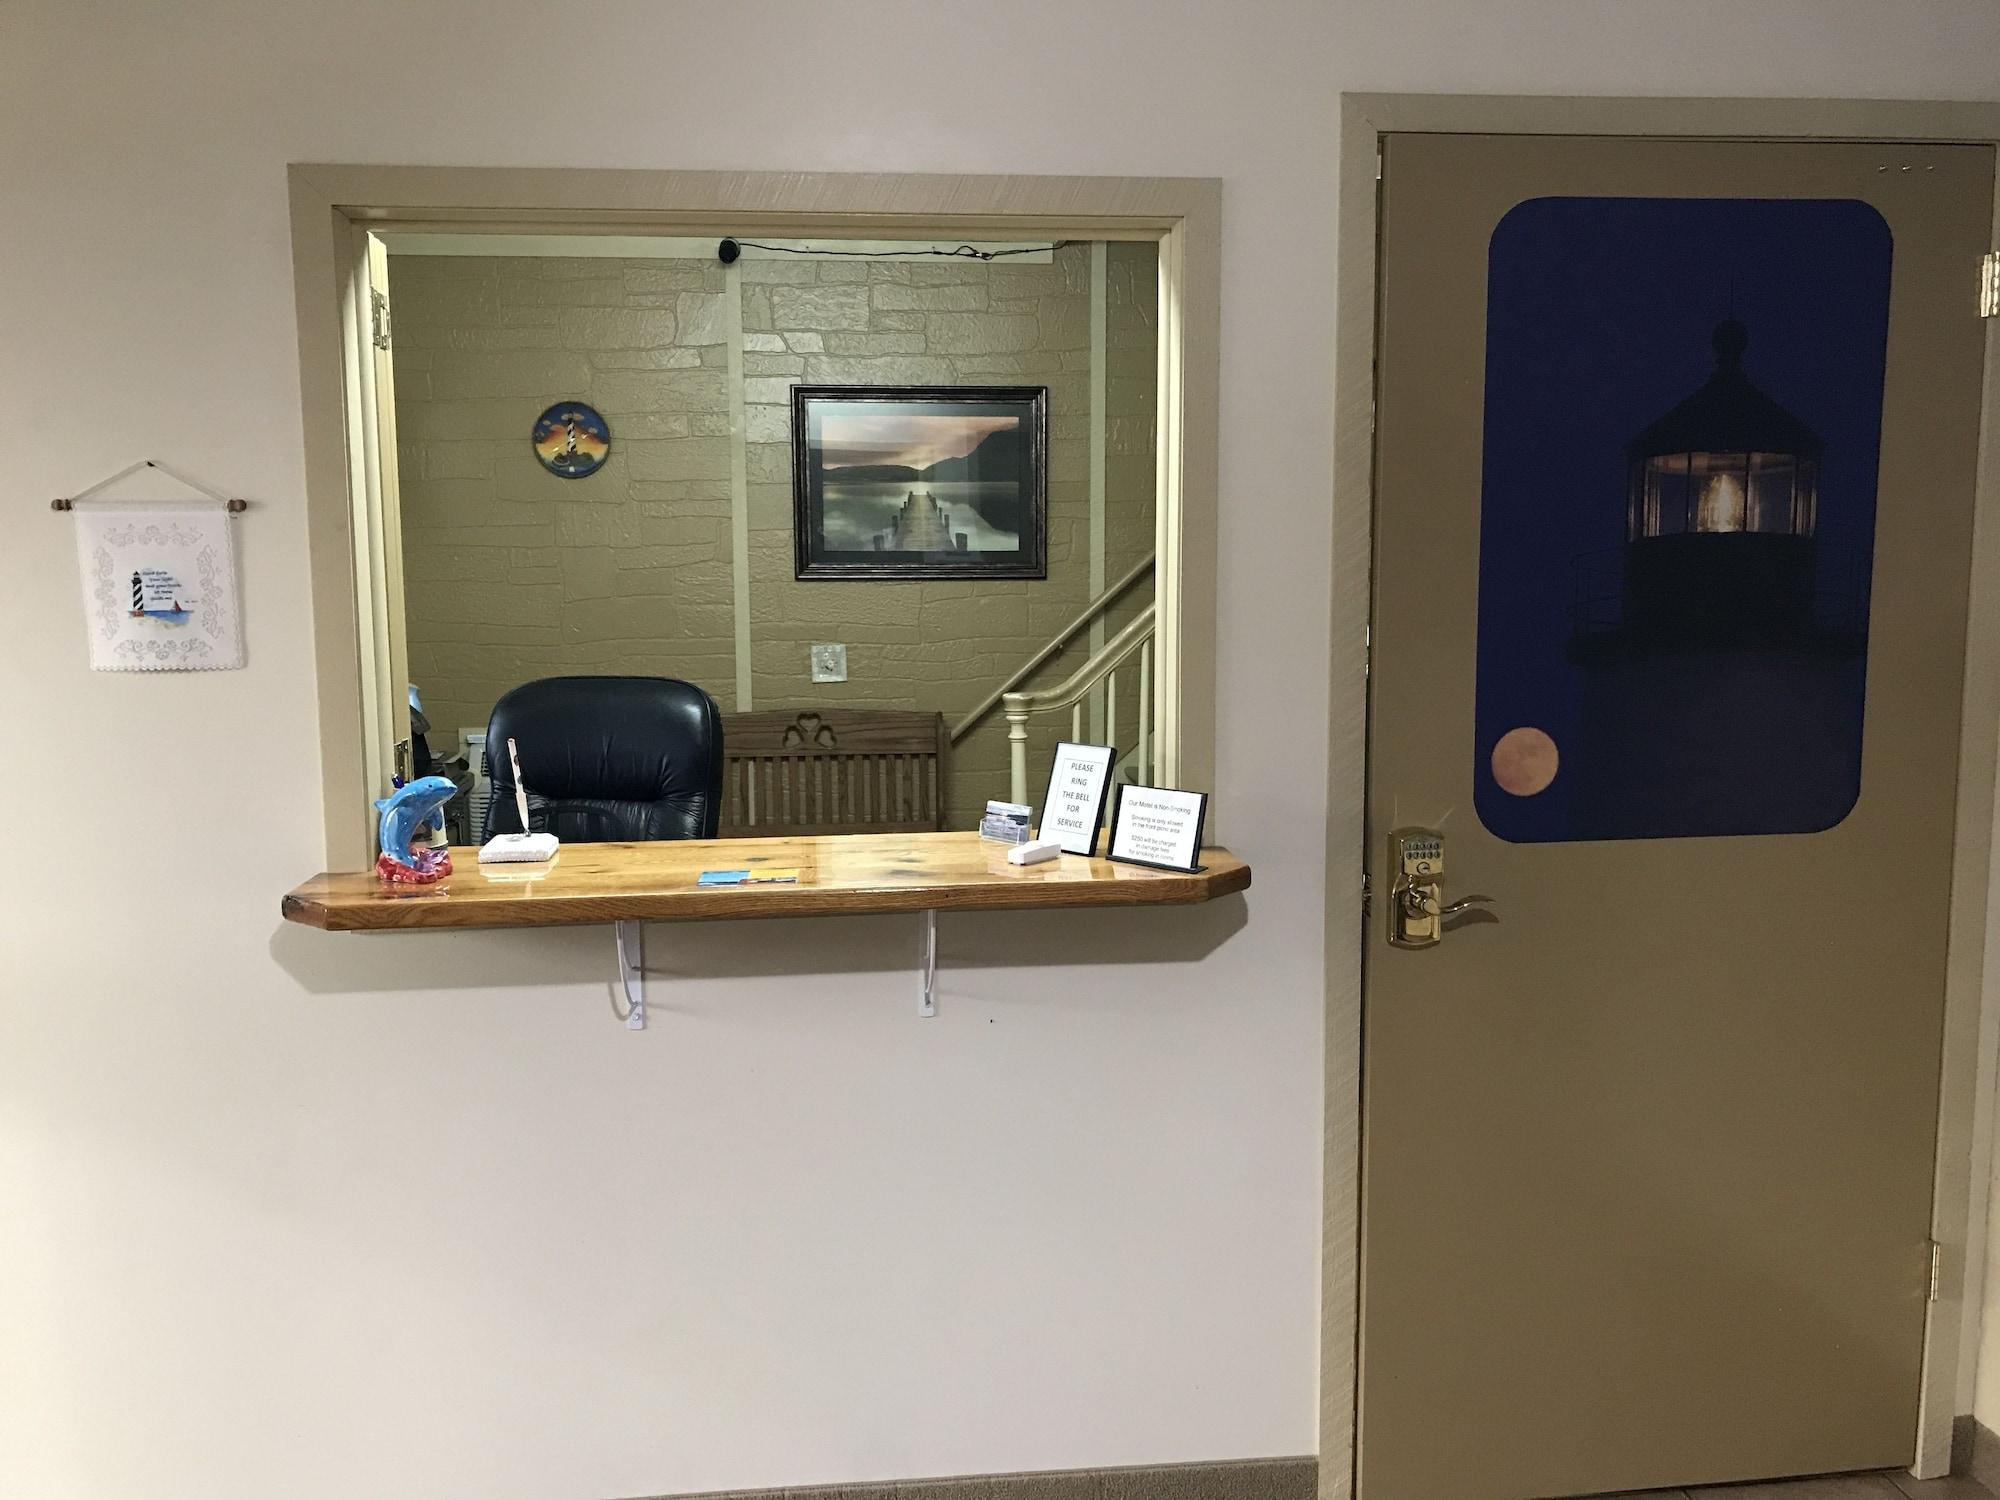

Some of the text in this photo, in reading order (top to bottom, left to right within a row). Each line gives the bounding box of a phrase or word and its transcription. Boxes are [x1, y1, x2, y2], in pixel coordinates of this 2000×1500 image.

[1071, 762, 1094, 772] PLEASE
[1071, 777, 1088, 786] RING
[1063, 790, 1090, 802] THE BELL
[1067, 804, 1080, 813] FOR
[1057, 817, 1083, 828] SERVICE
